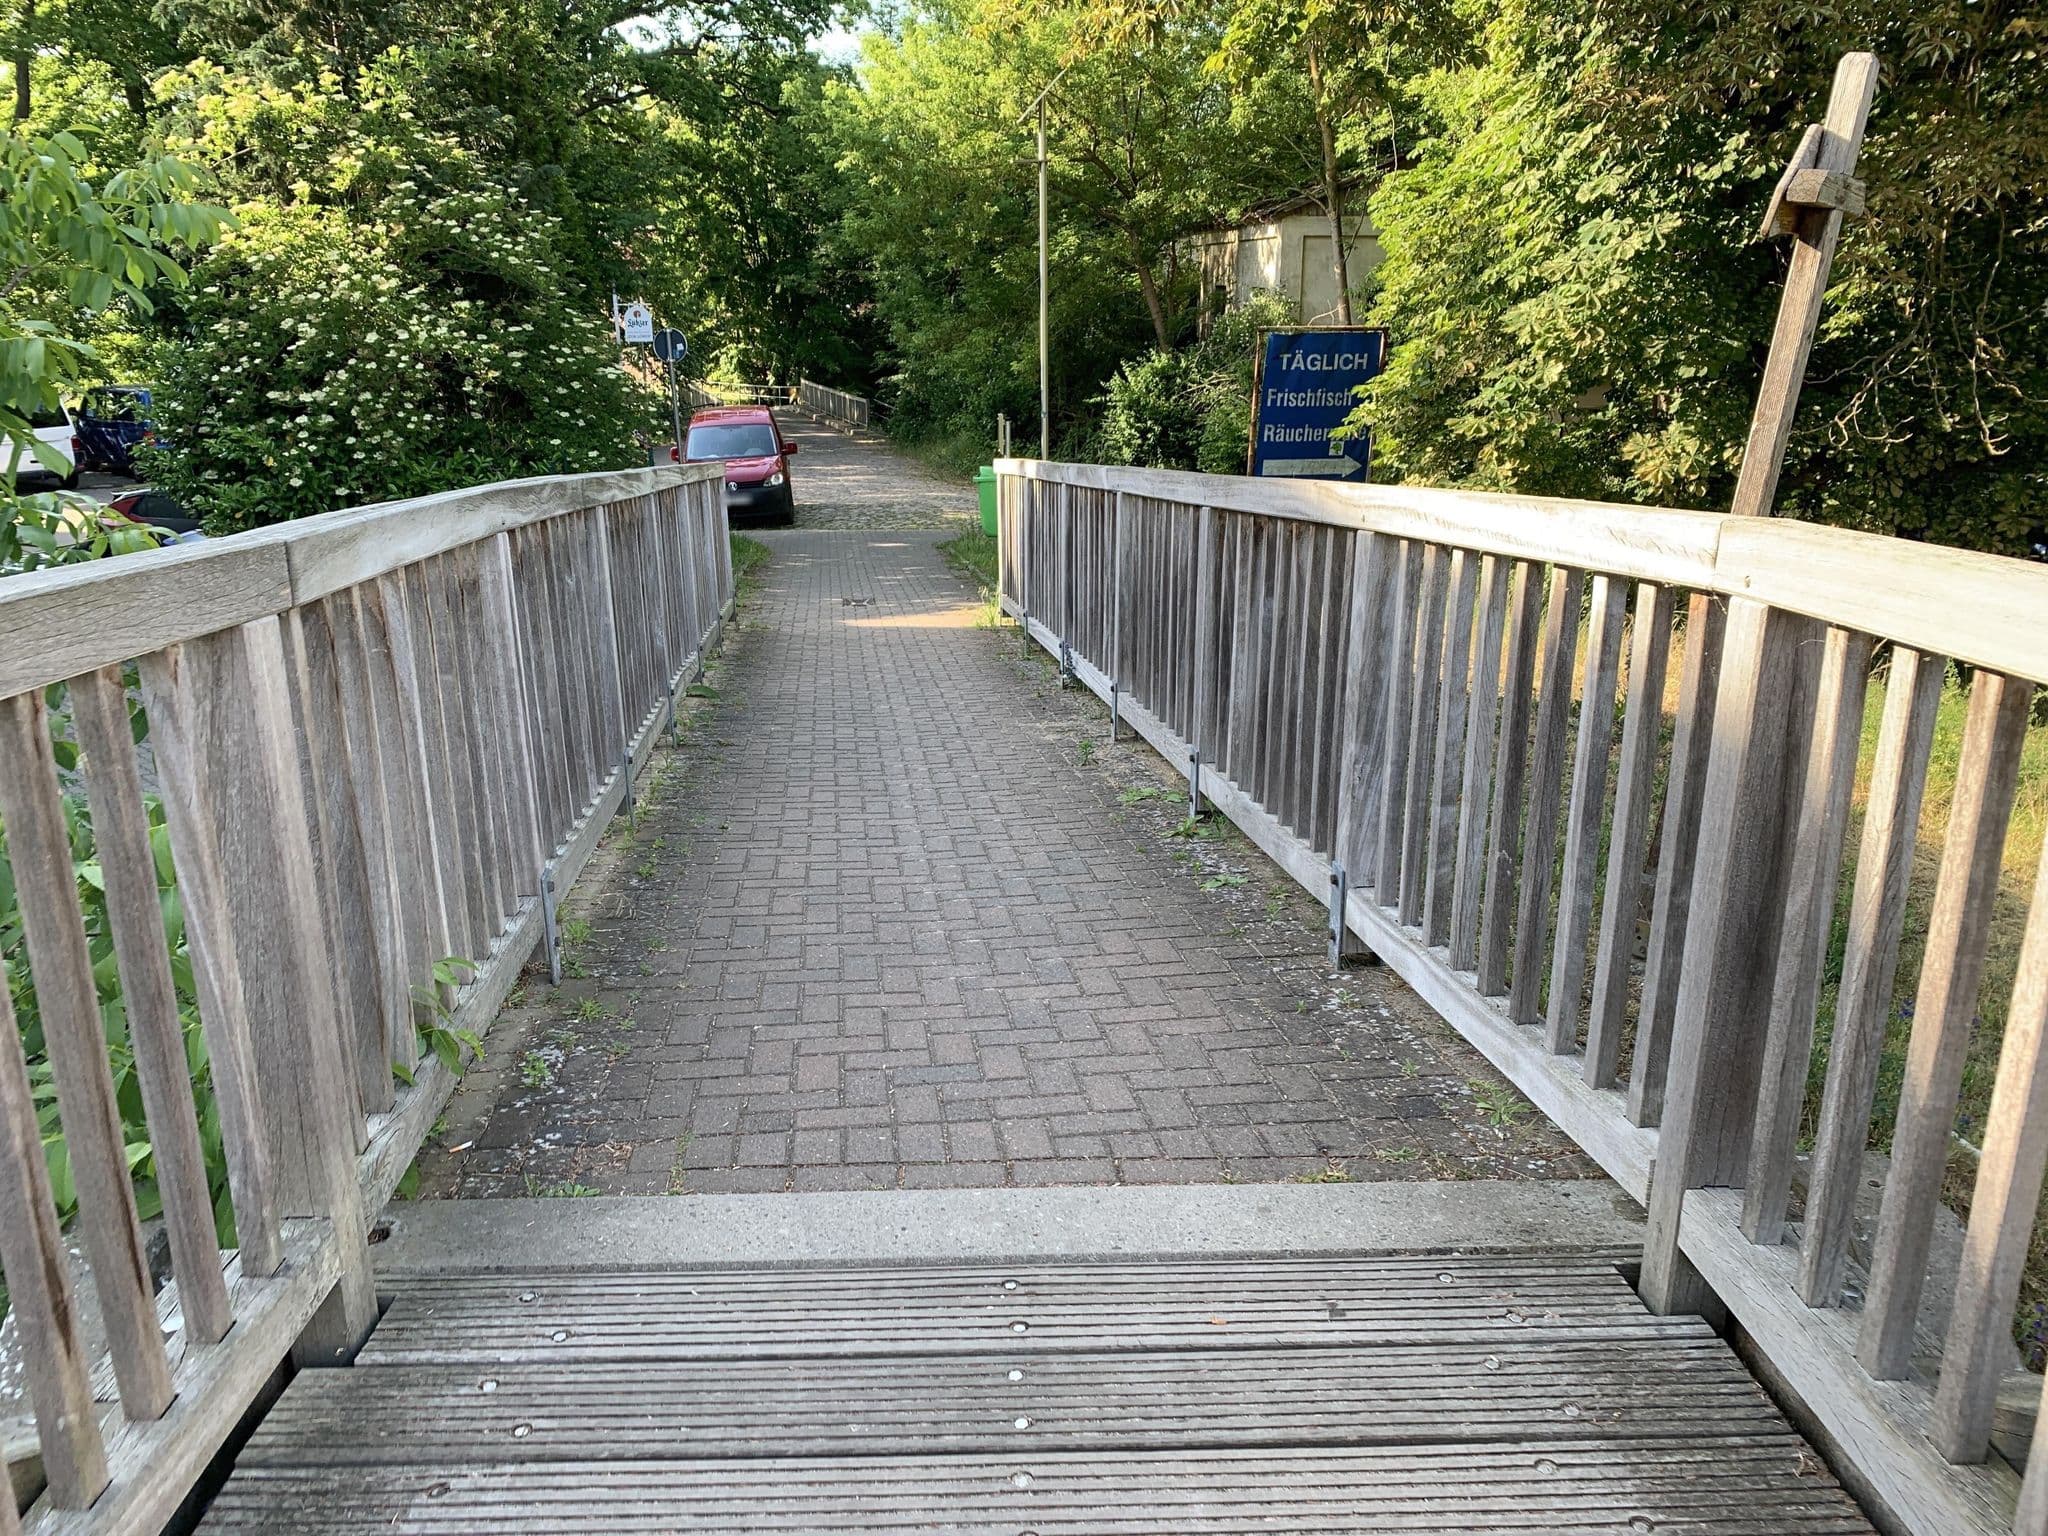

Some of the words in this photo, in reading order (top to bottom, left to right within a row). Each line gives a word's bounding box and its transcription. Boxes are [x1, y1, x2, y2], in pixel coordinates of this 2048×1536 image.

[1280, 350, 1368, 371] TÄGLICH
[1266, 388, 1352, 407] Frischfisch
[1263, 424, 1367, 442] Räuchere
